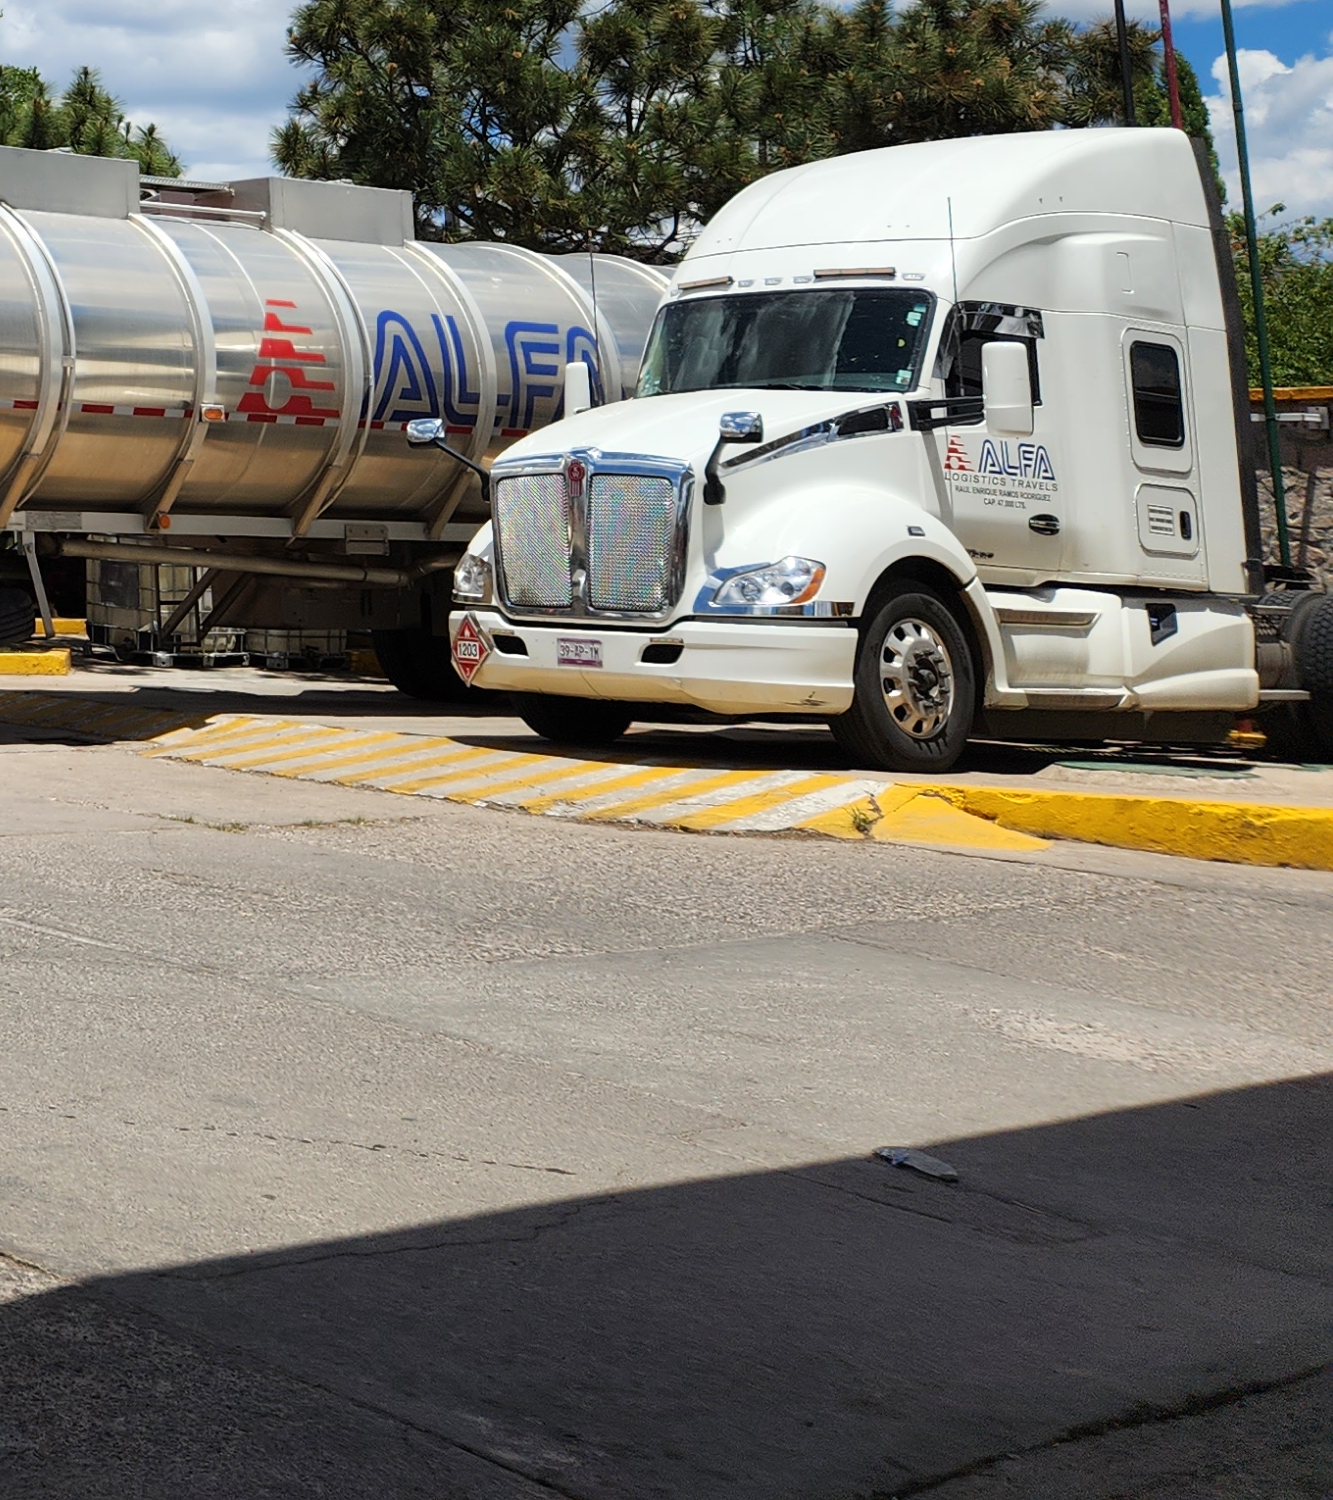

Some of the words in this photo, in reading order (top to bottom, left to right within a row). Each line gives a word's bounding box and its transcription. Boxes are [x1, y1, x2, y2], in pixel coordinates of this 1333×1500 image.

[978, 439, 1056, 481] ALFA
[944, 471, 1007, 486] LOGISTICS
[1010, 478, 1058, 491] TRAVELS
[458, 643, 478, 657] 1203
